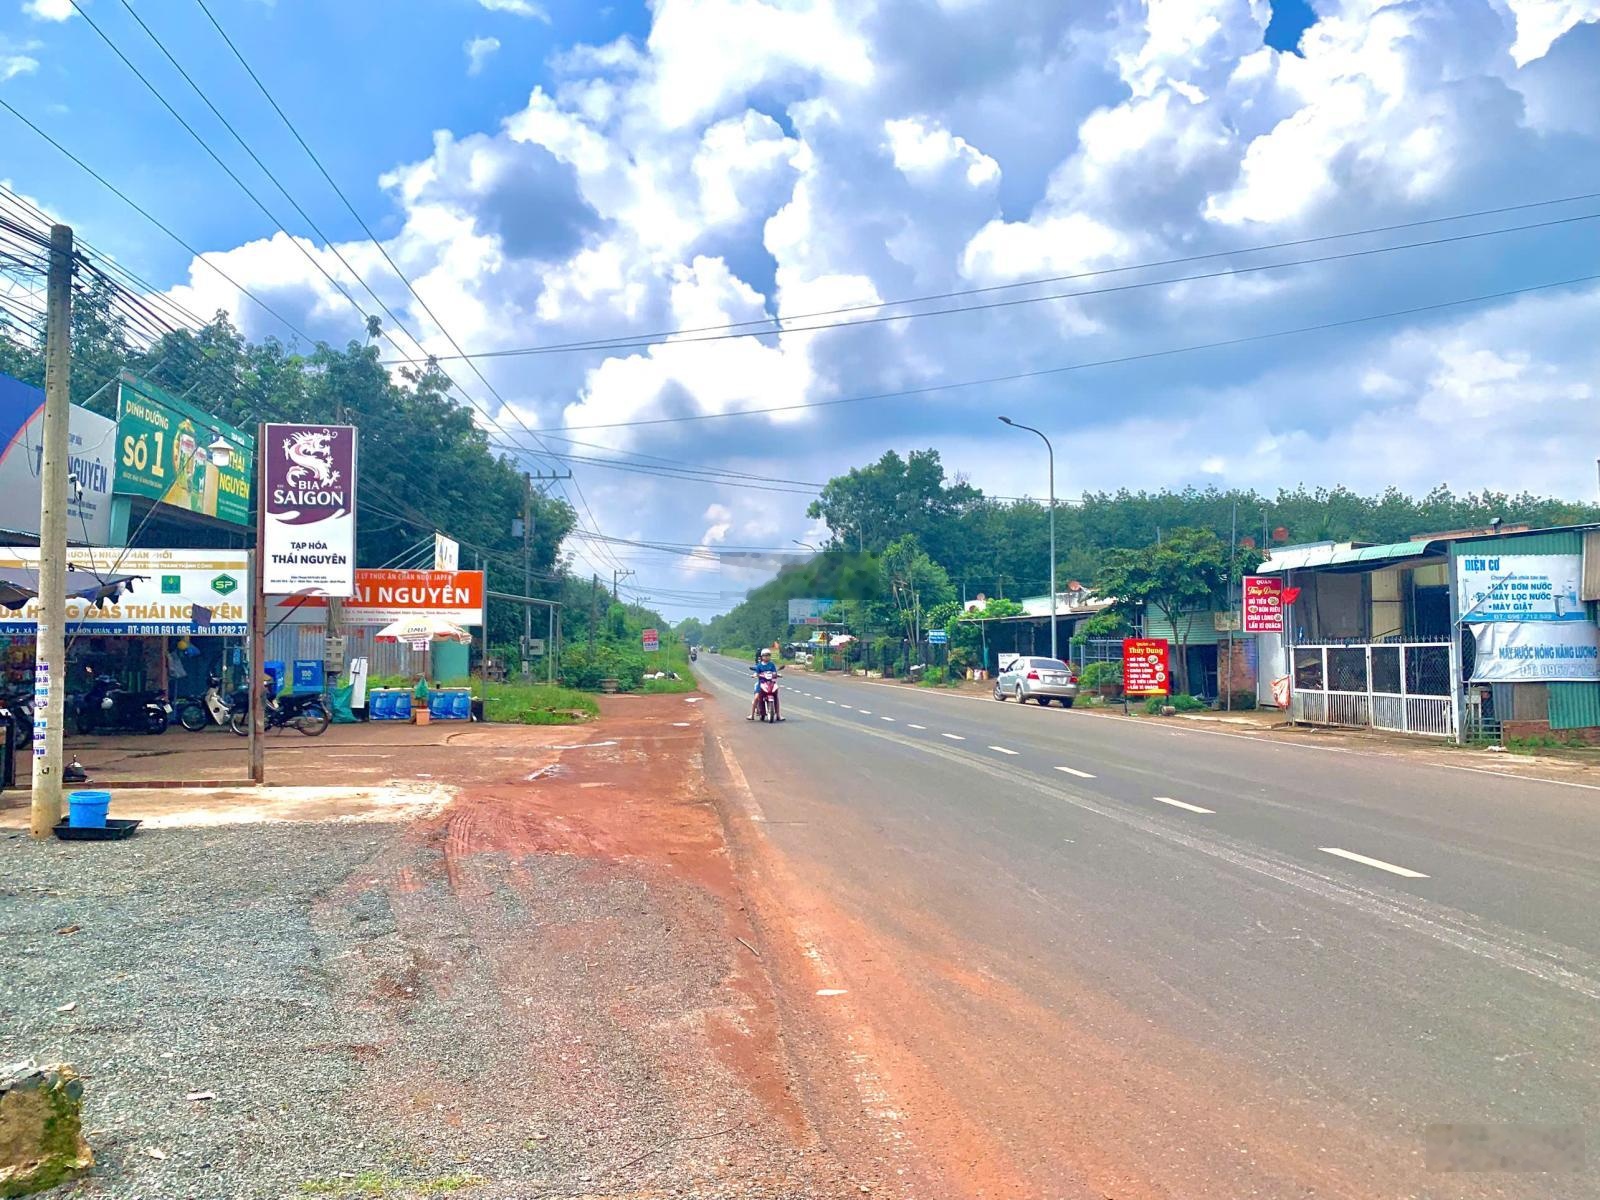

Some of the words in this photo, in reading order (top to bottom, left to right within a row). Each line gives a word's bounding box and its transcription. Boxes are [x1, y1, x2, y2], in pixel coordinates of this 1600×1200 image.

[126, 400, 144, 419] DINH
[122, 433, 148, 470] SỐ
[151, 431, 164, 477] 1
[219, 472, 250, 499] NGUYÊN
[298, 480, 320, 490] BIA
[273, 489, 344, 506] SAIGON
[291, 542, 307, 551] TẠP
[308, 540, 328, 550] HÓA
[272, 552, 298, 564] THÁI
[300, 553, 346, 565] NGUYÊN
[215, 581, 233, 589] SP
[378, 584, 470, 604] NGUYÊN
[83, 605, 121, 619] GAS
[125, 602, 166, 619] THÁI
[169, 602, 243, 619] NGYÊN
